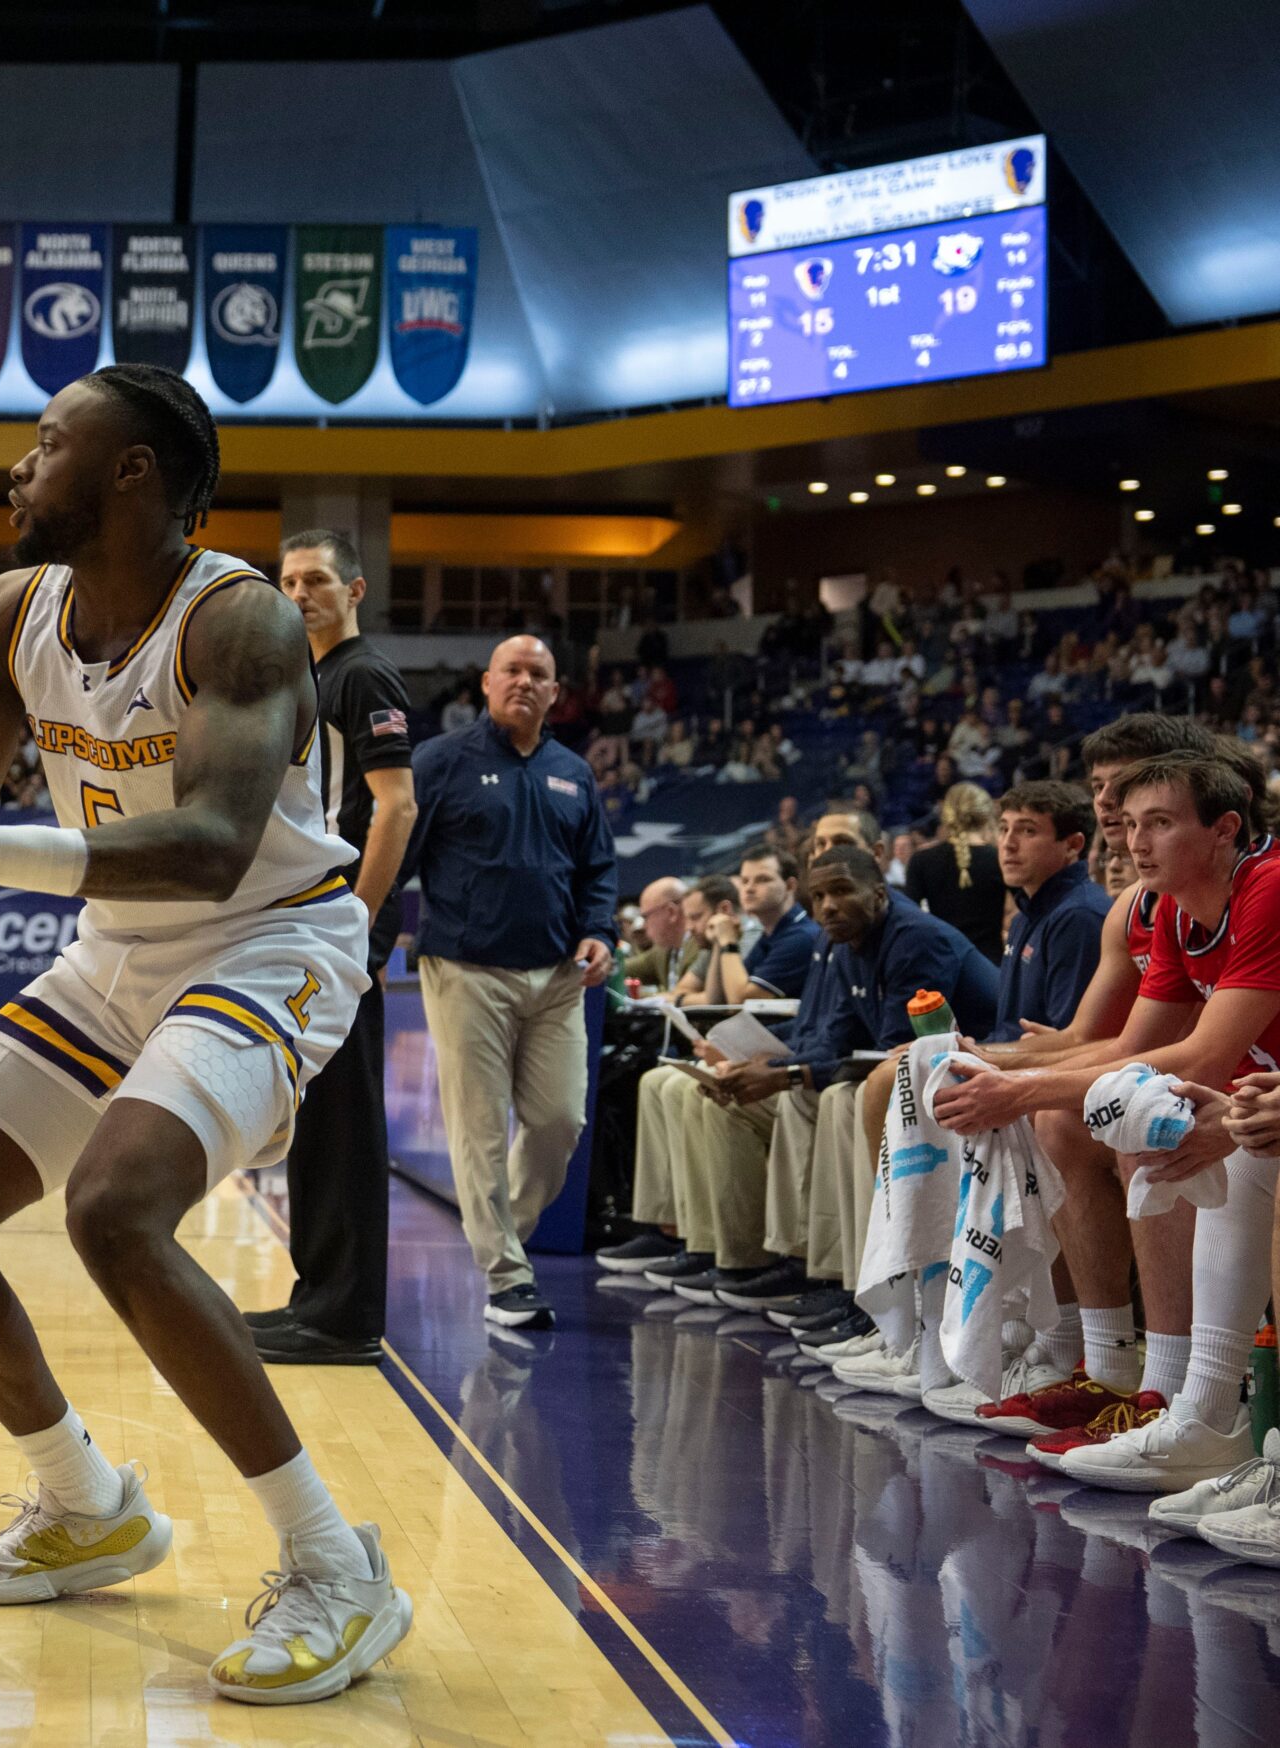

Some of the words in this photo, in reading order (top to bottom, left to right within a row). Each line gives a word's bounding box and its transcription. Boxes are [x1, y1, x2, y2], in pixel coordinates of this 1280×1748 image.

[37, 233, 93, 252] NORTH
[25, 250, 102, 271] ALABAMA
[212, 253, 278, 273] QUEENS
[854, 240, 917, 275] 7:31
[798, 306, 835, 337] 15
